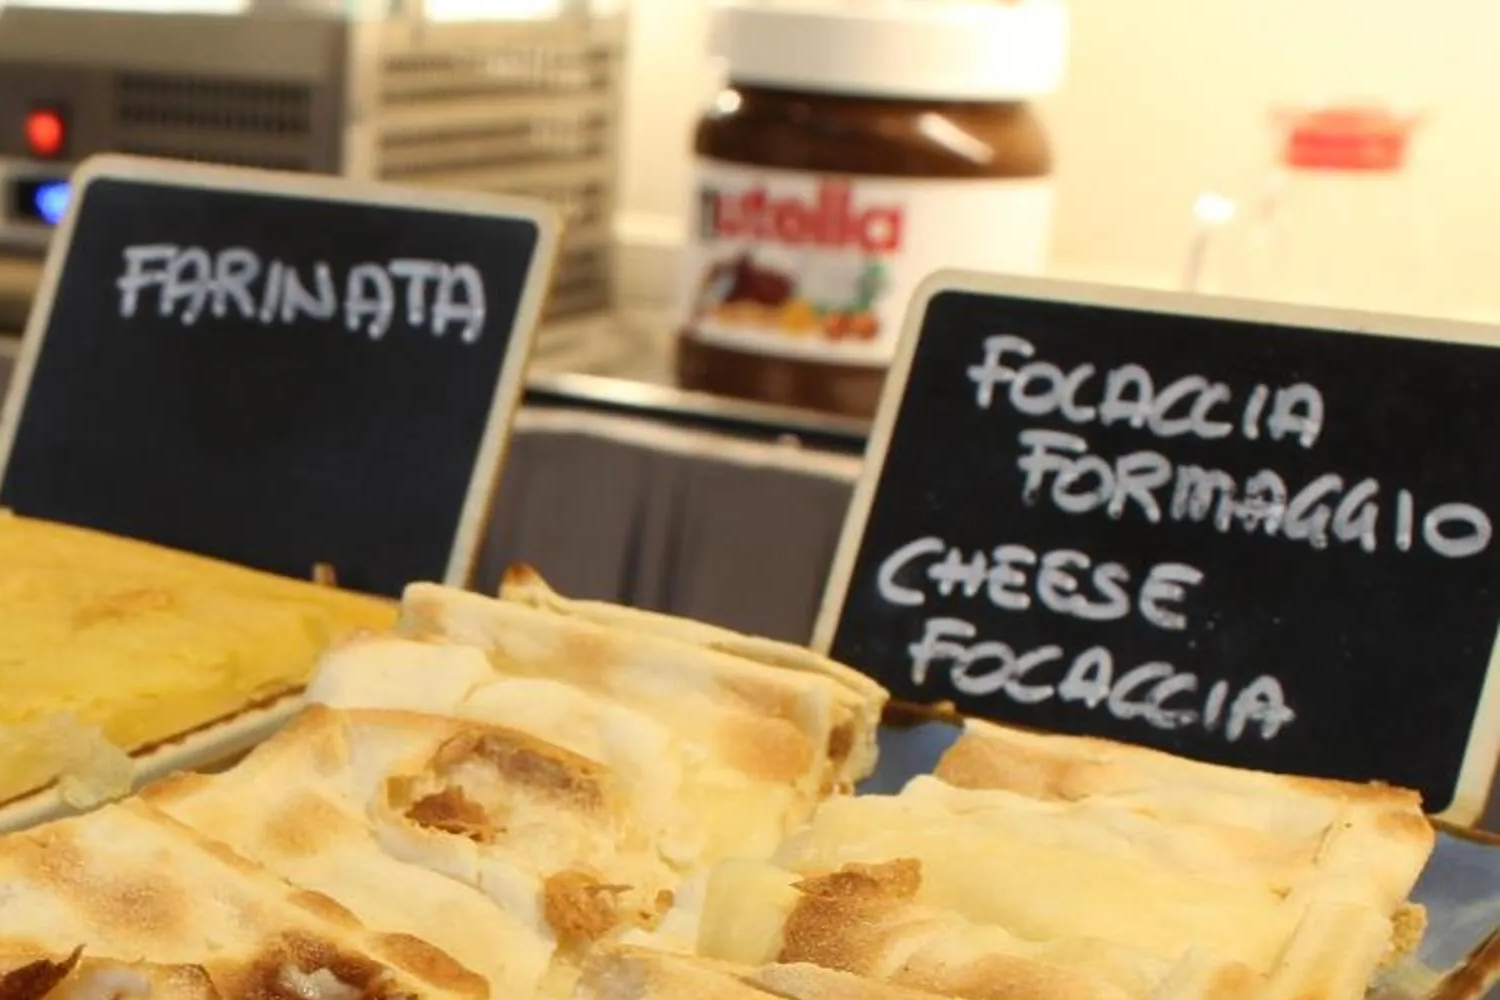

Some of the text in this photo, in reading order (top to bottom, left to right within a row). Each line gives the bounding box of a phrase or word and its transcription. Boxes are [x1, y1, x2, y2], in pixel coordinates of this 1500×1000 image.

[117, 244, 485, 343] FARINATA
[967, 334, 1325, 448] FOCACCIA
[1017, 430, 1493, 557] FORMAGGIO
[876, 537, 1204, 629] CHEESE
[908, 617, 1296, 742] FOCACCIA
